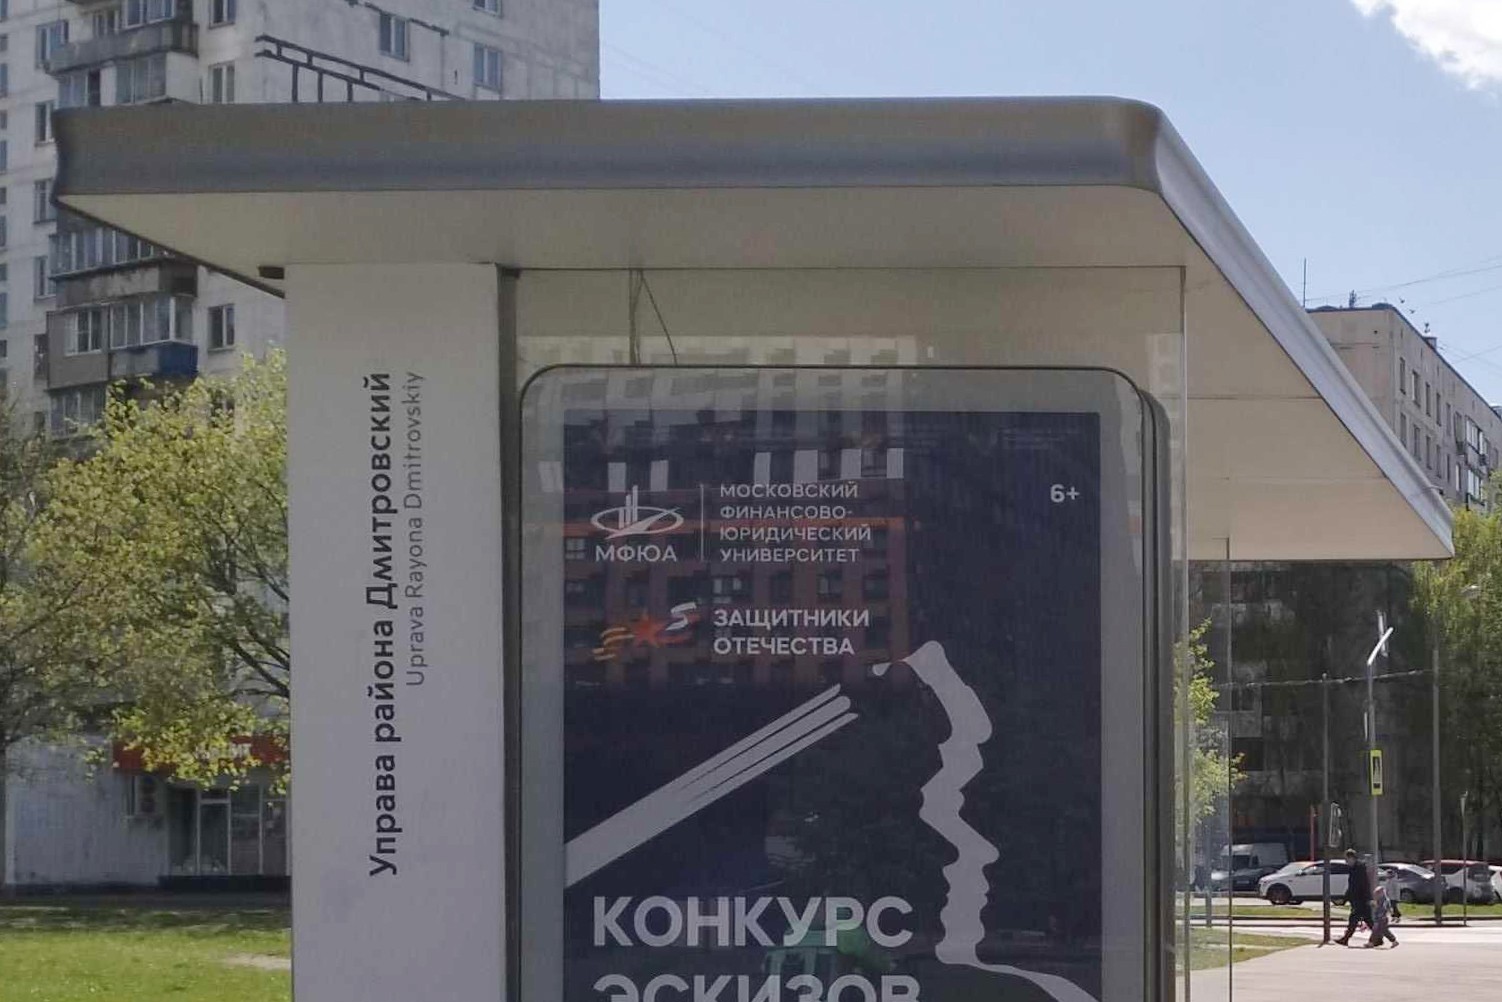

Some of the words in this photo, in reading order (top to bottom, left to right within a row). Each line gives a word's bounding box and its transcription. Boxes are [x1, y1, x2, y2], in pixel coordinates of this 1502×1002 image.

[402, 371, 425, 510] Dmitrovskiy
[363, 372, 398, 610] Дмитровский
[719, 480, 859, 498] МОСКОВСКИЙ
[1049, 484, 1080, 503] 6+
[719, 504, 853, 521] ФИНАНСОВО-
[719, 523, 872, 543] ЮРИДИЧЕСКИЙ
[404, 515, 427, 599] Rayona
[595, 544, 678, 563] МФЮА
[719, 547, 860, 563] УНИВЕРСИТЕТ
[712, 608, 870, 630] ЗАЩИТНИКИ
[406, 606, 428, 687] Uprava
[712, 636, 855, 656] ОТЕЧЕСТВА
[367, 619, 401, 742] района
[369, 753, 402, 877] Управа
[593, 895, 914, 947] КОНКУРС
